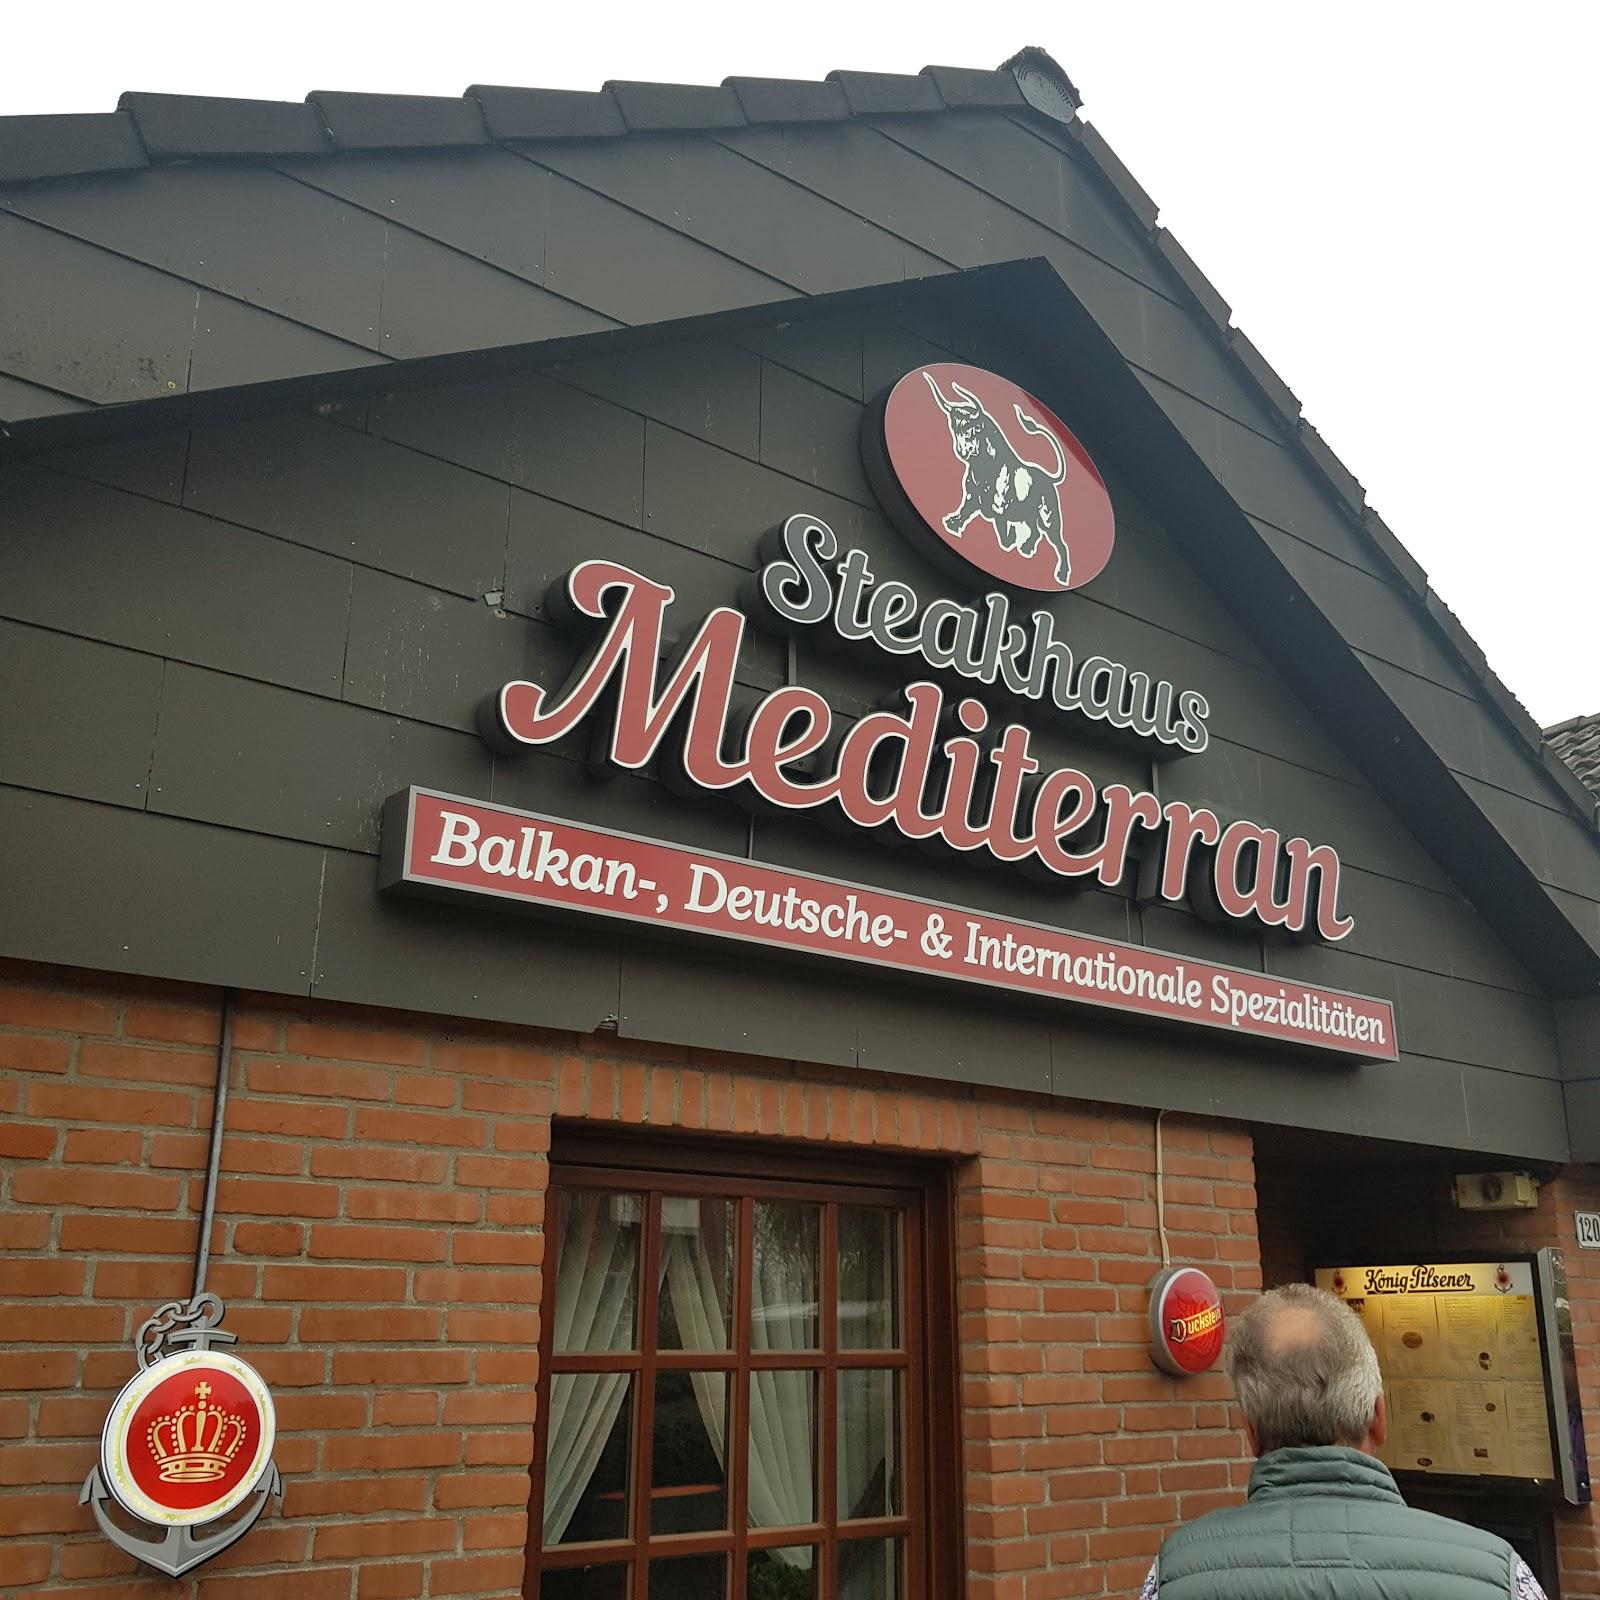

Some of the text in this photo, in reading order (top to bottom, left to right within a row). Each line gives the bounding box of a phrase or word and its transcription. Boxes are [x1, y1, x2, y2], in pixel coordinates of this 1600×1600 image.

[499, 559, 1356, 942] Mediterran
[761, 512, 1211, 755] Steakhaus
[430, 811, 1387, 1046] Balkan-, Deutsche- & Internationale Spezialitäten
[1578, 1216, 1600, 1242] 120
